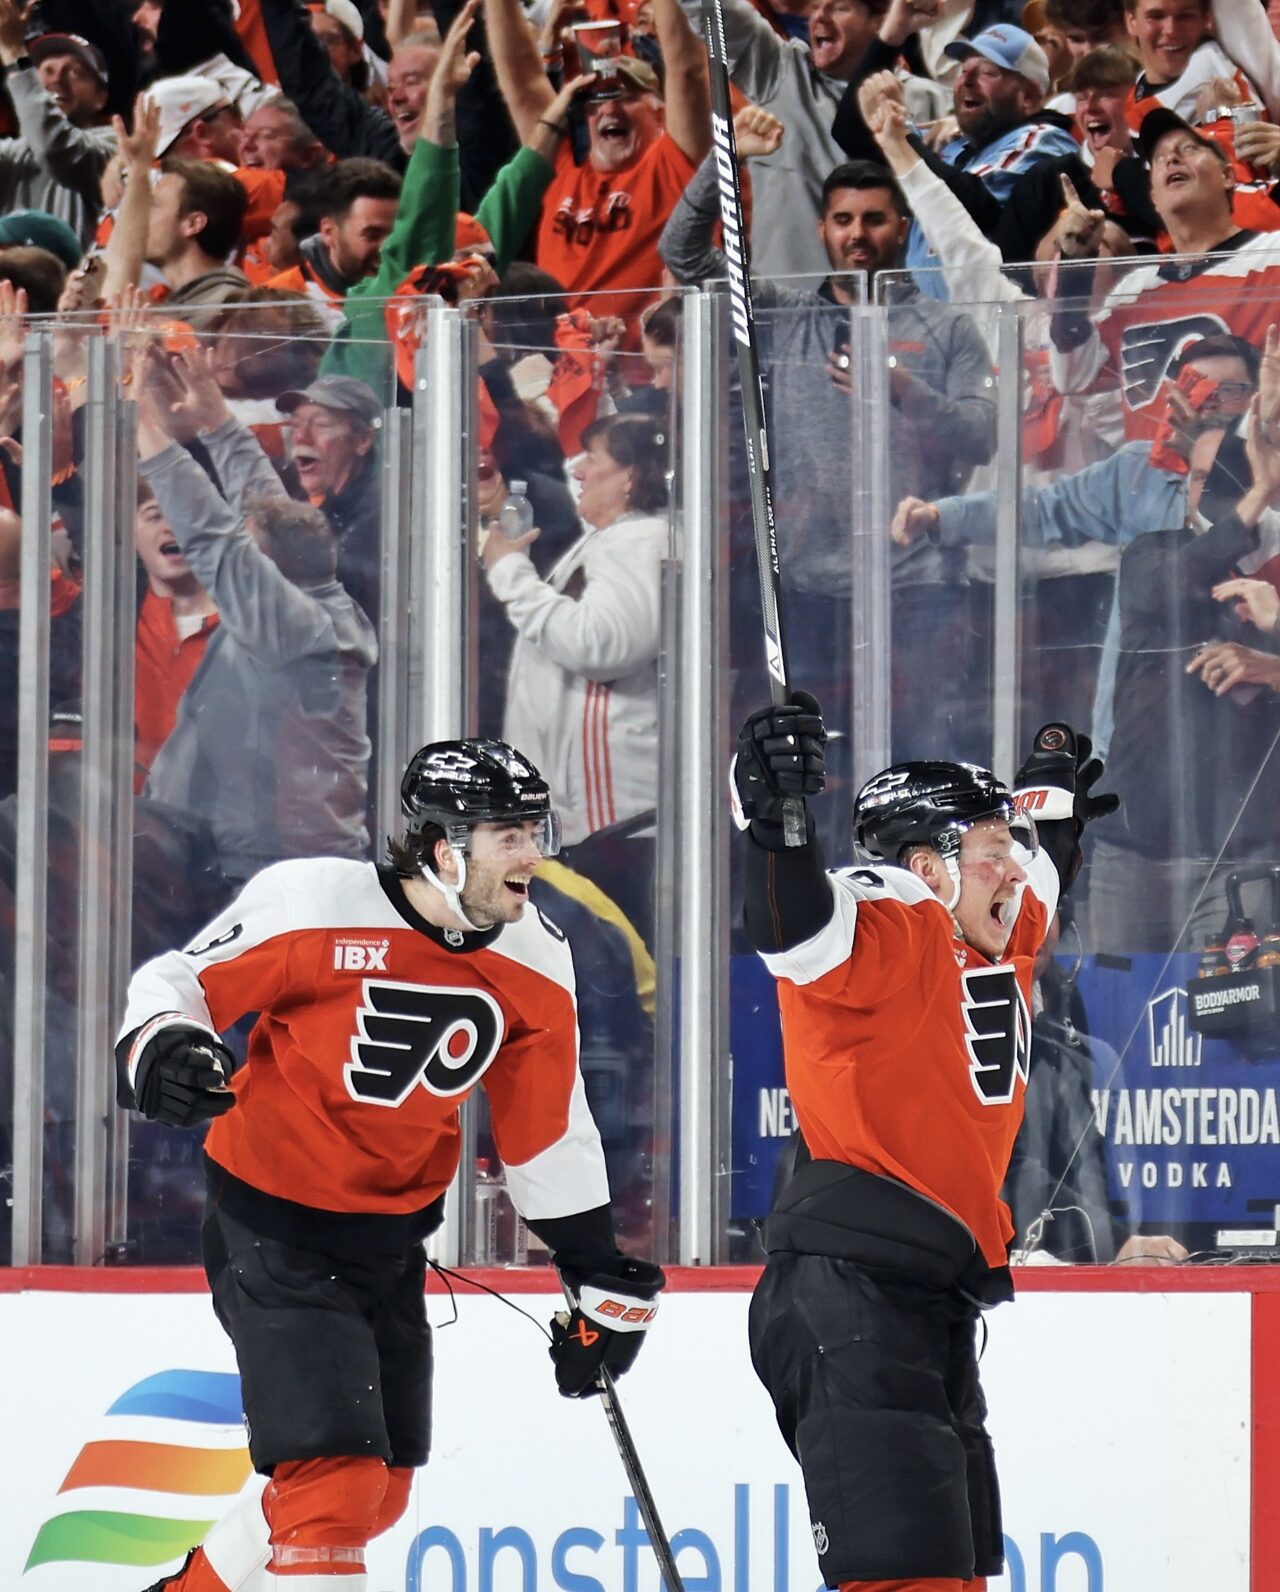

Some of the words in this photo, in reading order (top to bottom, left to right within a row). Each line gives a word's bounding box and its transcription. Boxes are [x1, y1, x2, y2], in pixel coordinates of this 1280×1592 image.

[712, 113, 751, 348] WARRIOR
[769, 529, 780, 574] ALPHA
[335, 938, 381, 946] Independence
[333, 945, 389, 971] IBX
[1194, 984, 1260, 1010] BODYARMOR
[1118, 1162, 1232, 1188] VODKA
